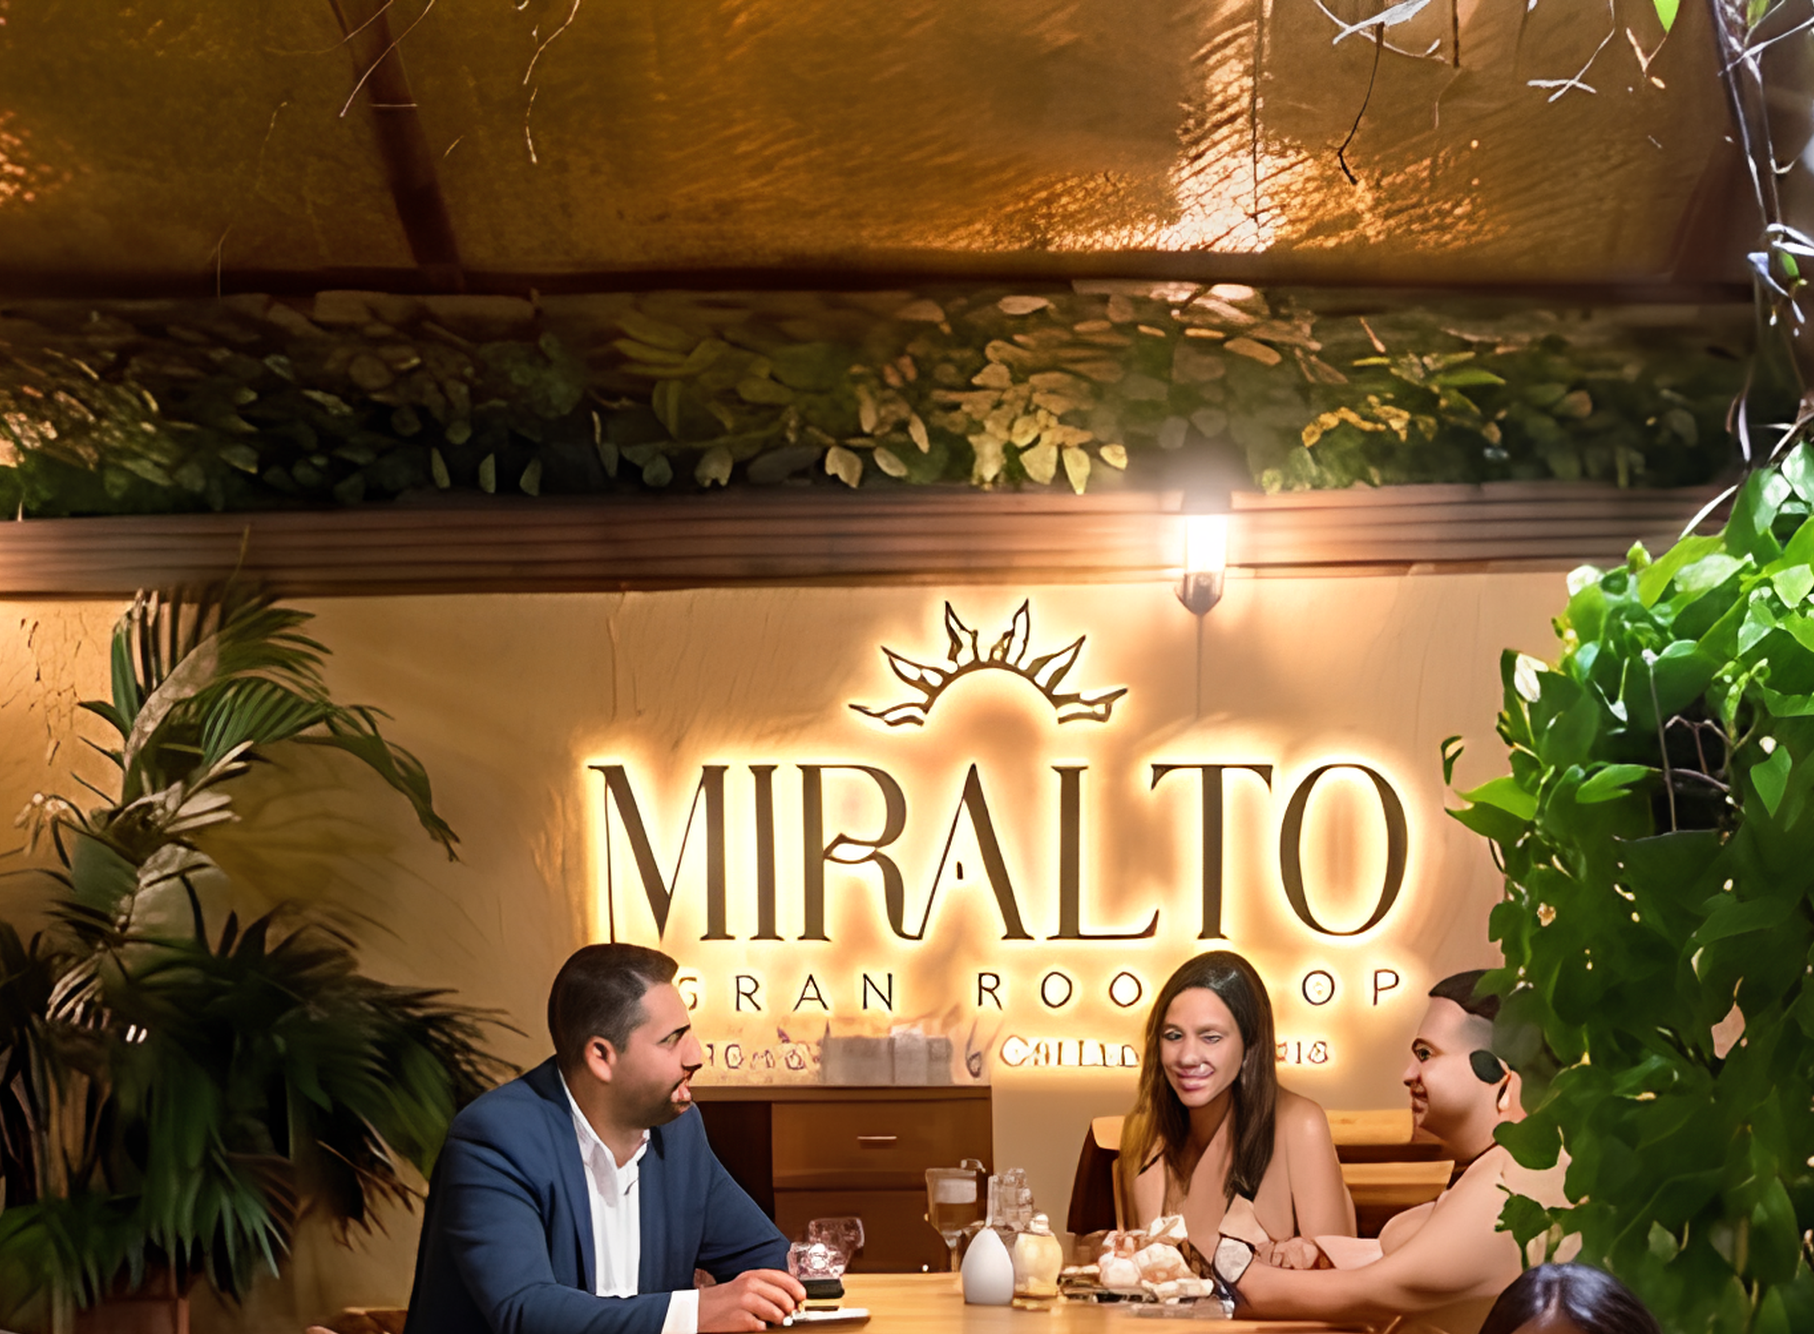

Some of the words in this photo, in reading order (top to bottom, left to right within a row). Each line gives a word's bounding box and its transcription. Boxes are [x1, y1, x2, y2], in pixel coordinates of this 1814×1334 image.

[587, 763, 1408, 943] MIRALTO
[678, 972, 894, 1012] GRAN
[977, 969, 1400, 1011] ROOOP
